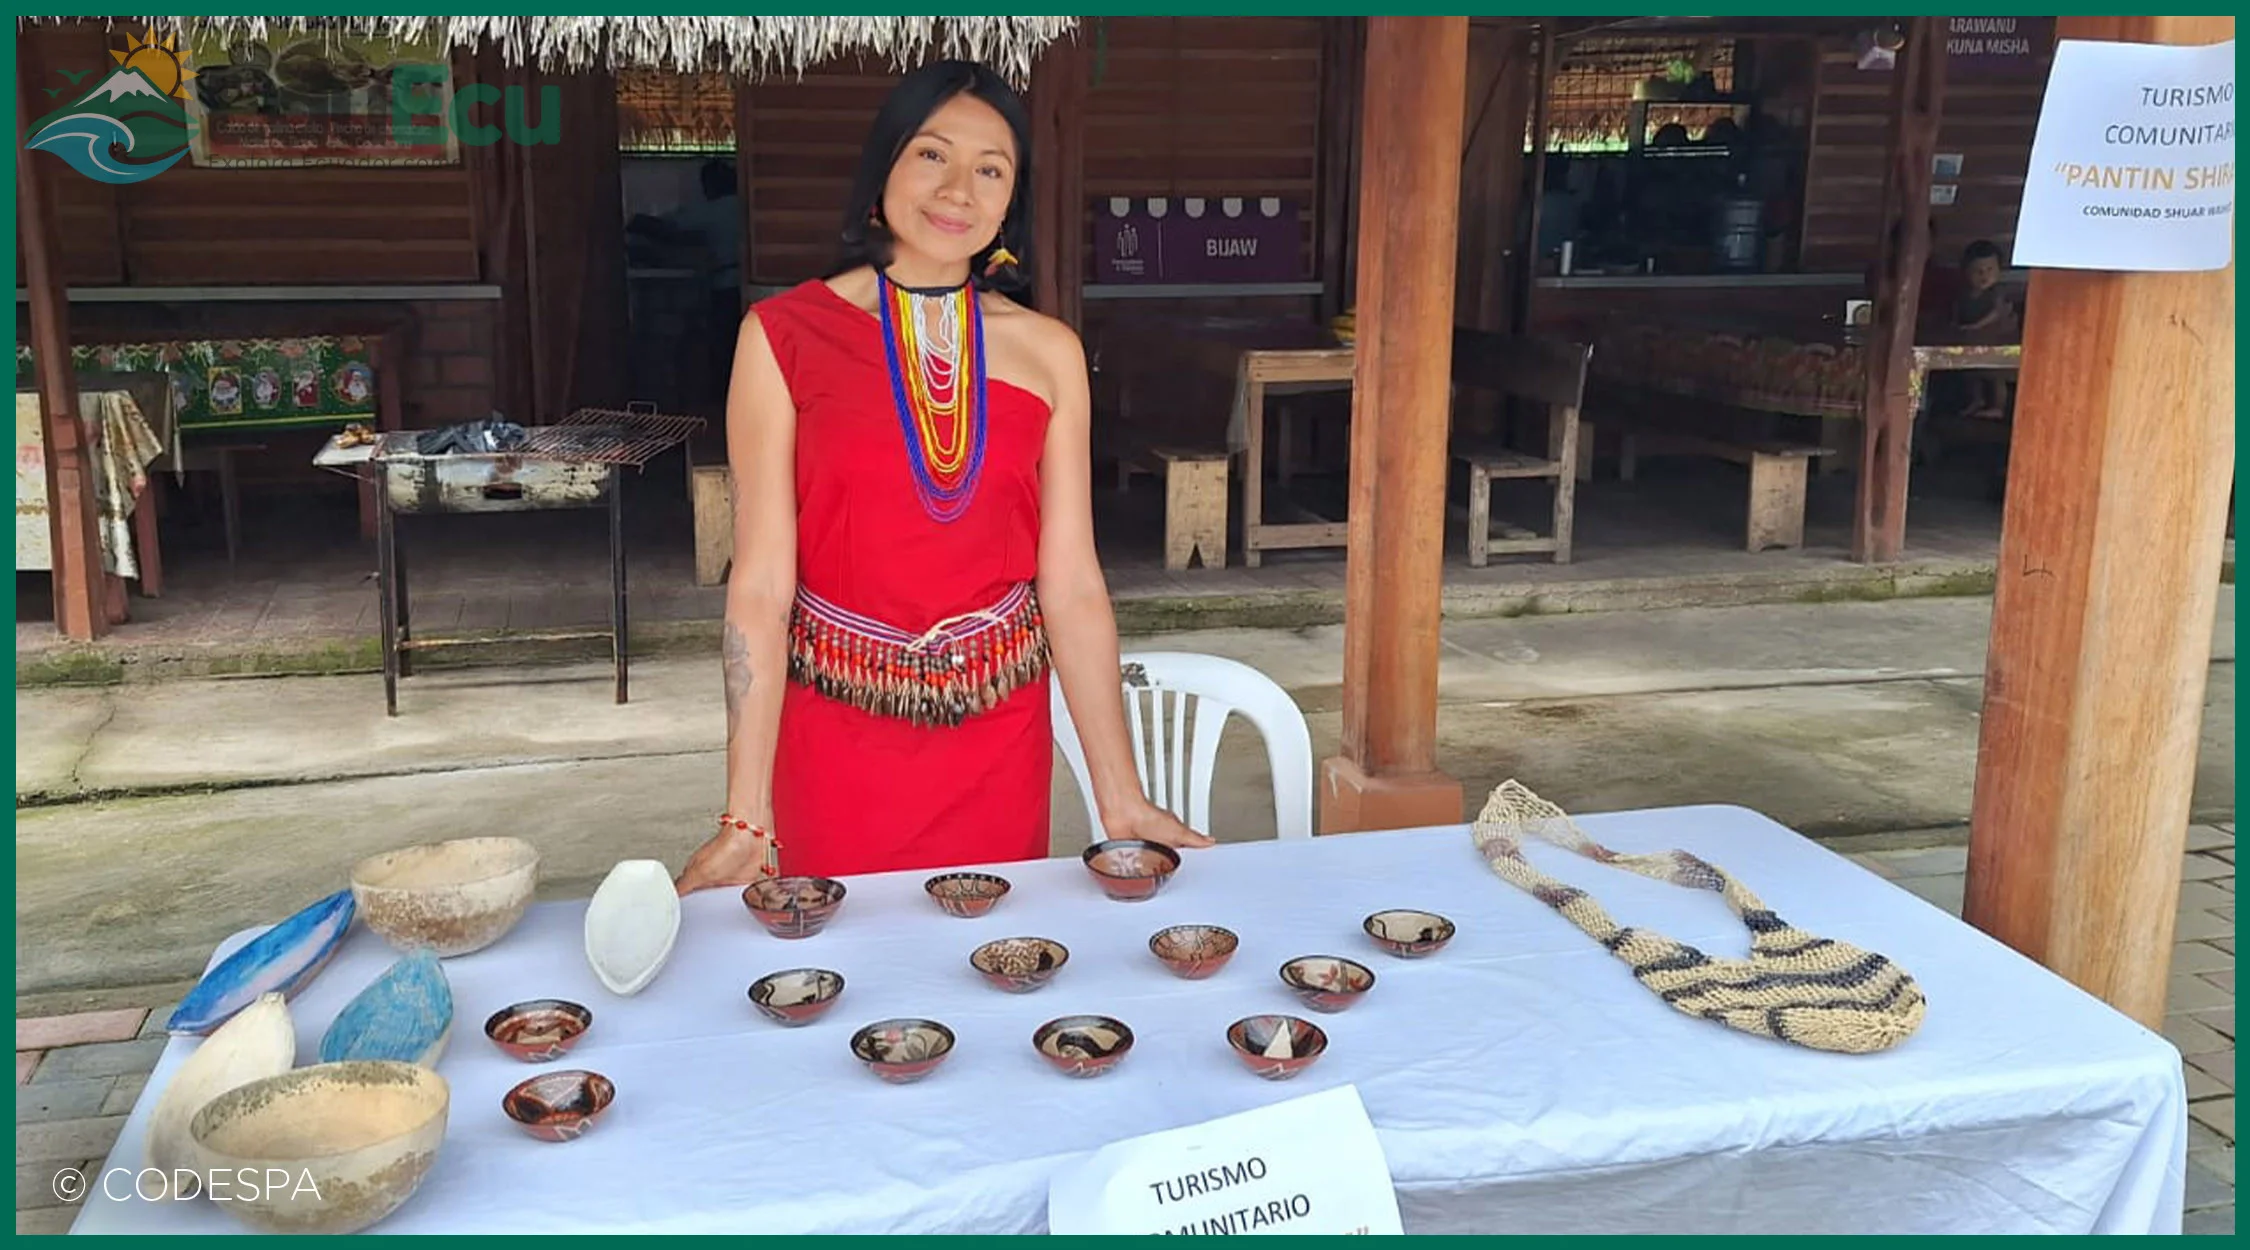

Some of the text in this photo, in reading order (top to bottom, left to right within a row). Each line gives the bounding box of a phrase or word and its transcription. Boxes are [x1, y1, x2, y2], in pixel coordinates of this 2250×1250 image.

[1986, 38, 2030, 56] MISHA
[2141, 82, 2234, 108] TURISMO
[2083, 204, 2161, 219] COMUNIDAD
[2164, 206, 2206, 219] SHUAR
[1149, 1156, 1268, 1205] TURISMO
[1149, 1193, 1311, 1235] MUNITARIO
